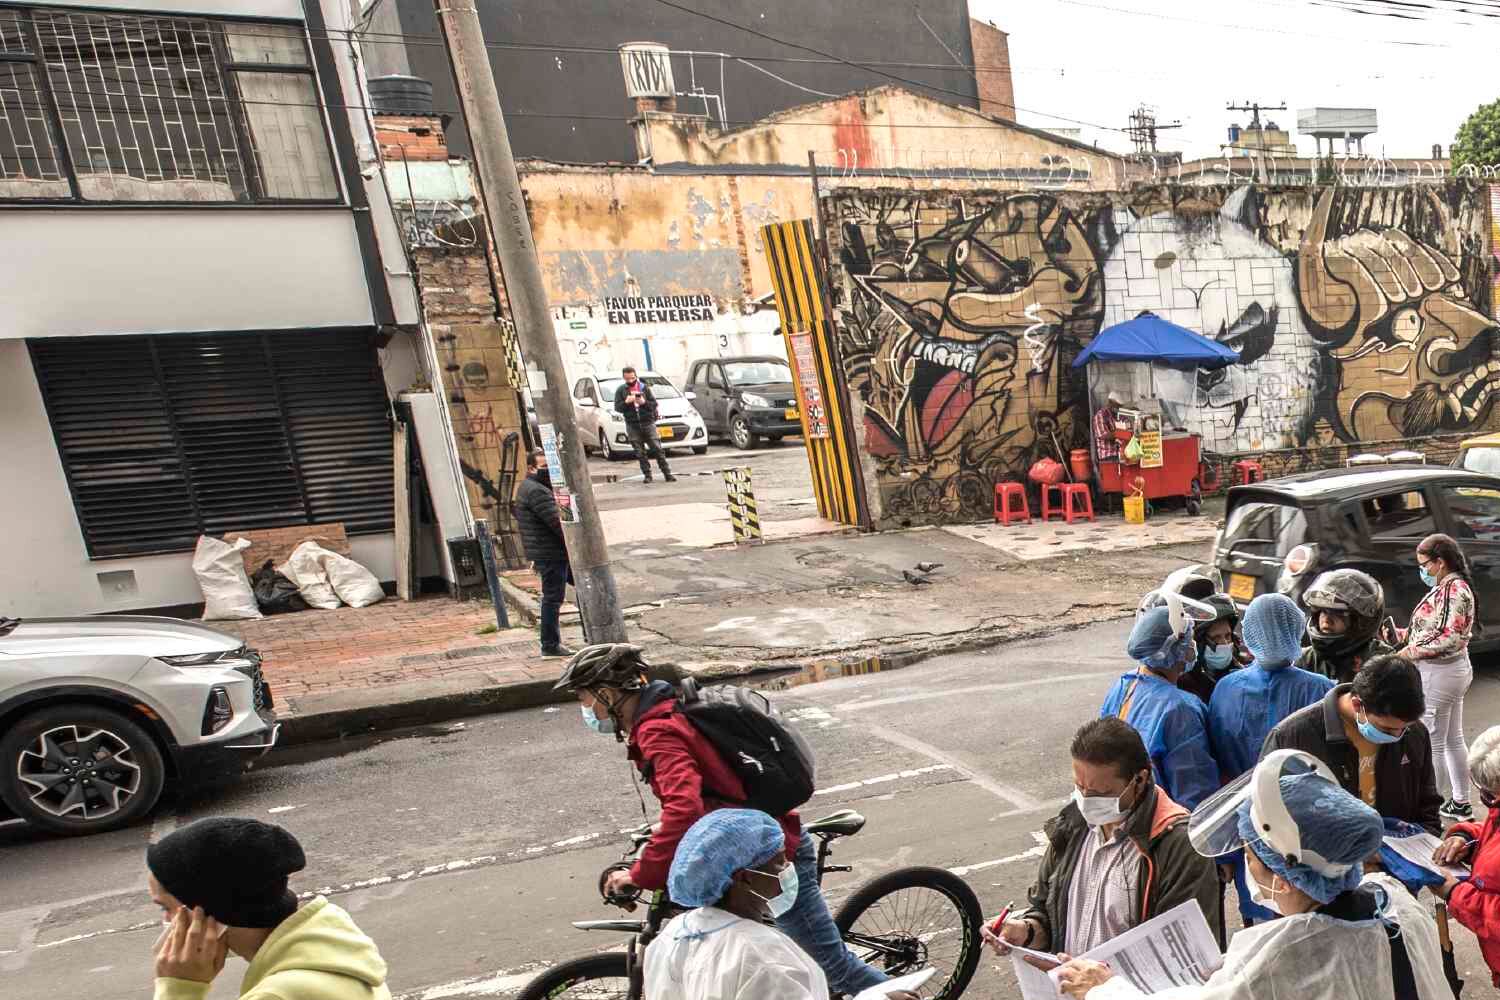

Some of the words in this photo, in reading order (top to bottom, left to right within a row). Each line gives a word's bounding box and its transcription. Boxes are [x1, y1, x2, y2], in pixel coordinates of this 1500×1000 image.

[605, 296, 646, 310] FAVOR
[648, 294, 713, 309] PARQUEAR
[607, 310, 631, 325] EN
[634, 307, 715, 324] REVERSA
[578, 341, 589, 355] 2
[719, 334, 728, 348] 3
